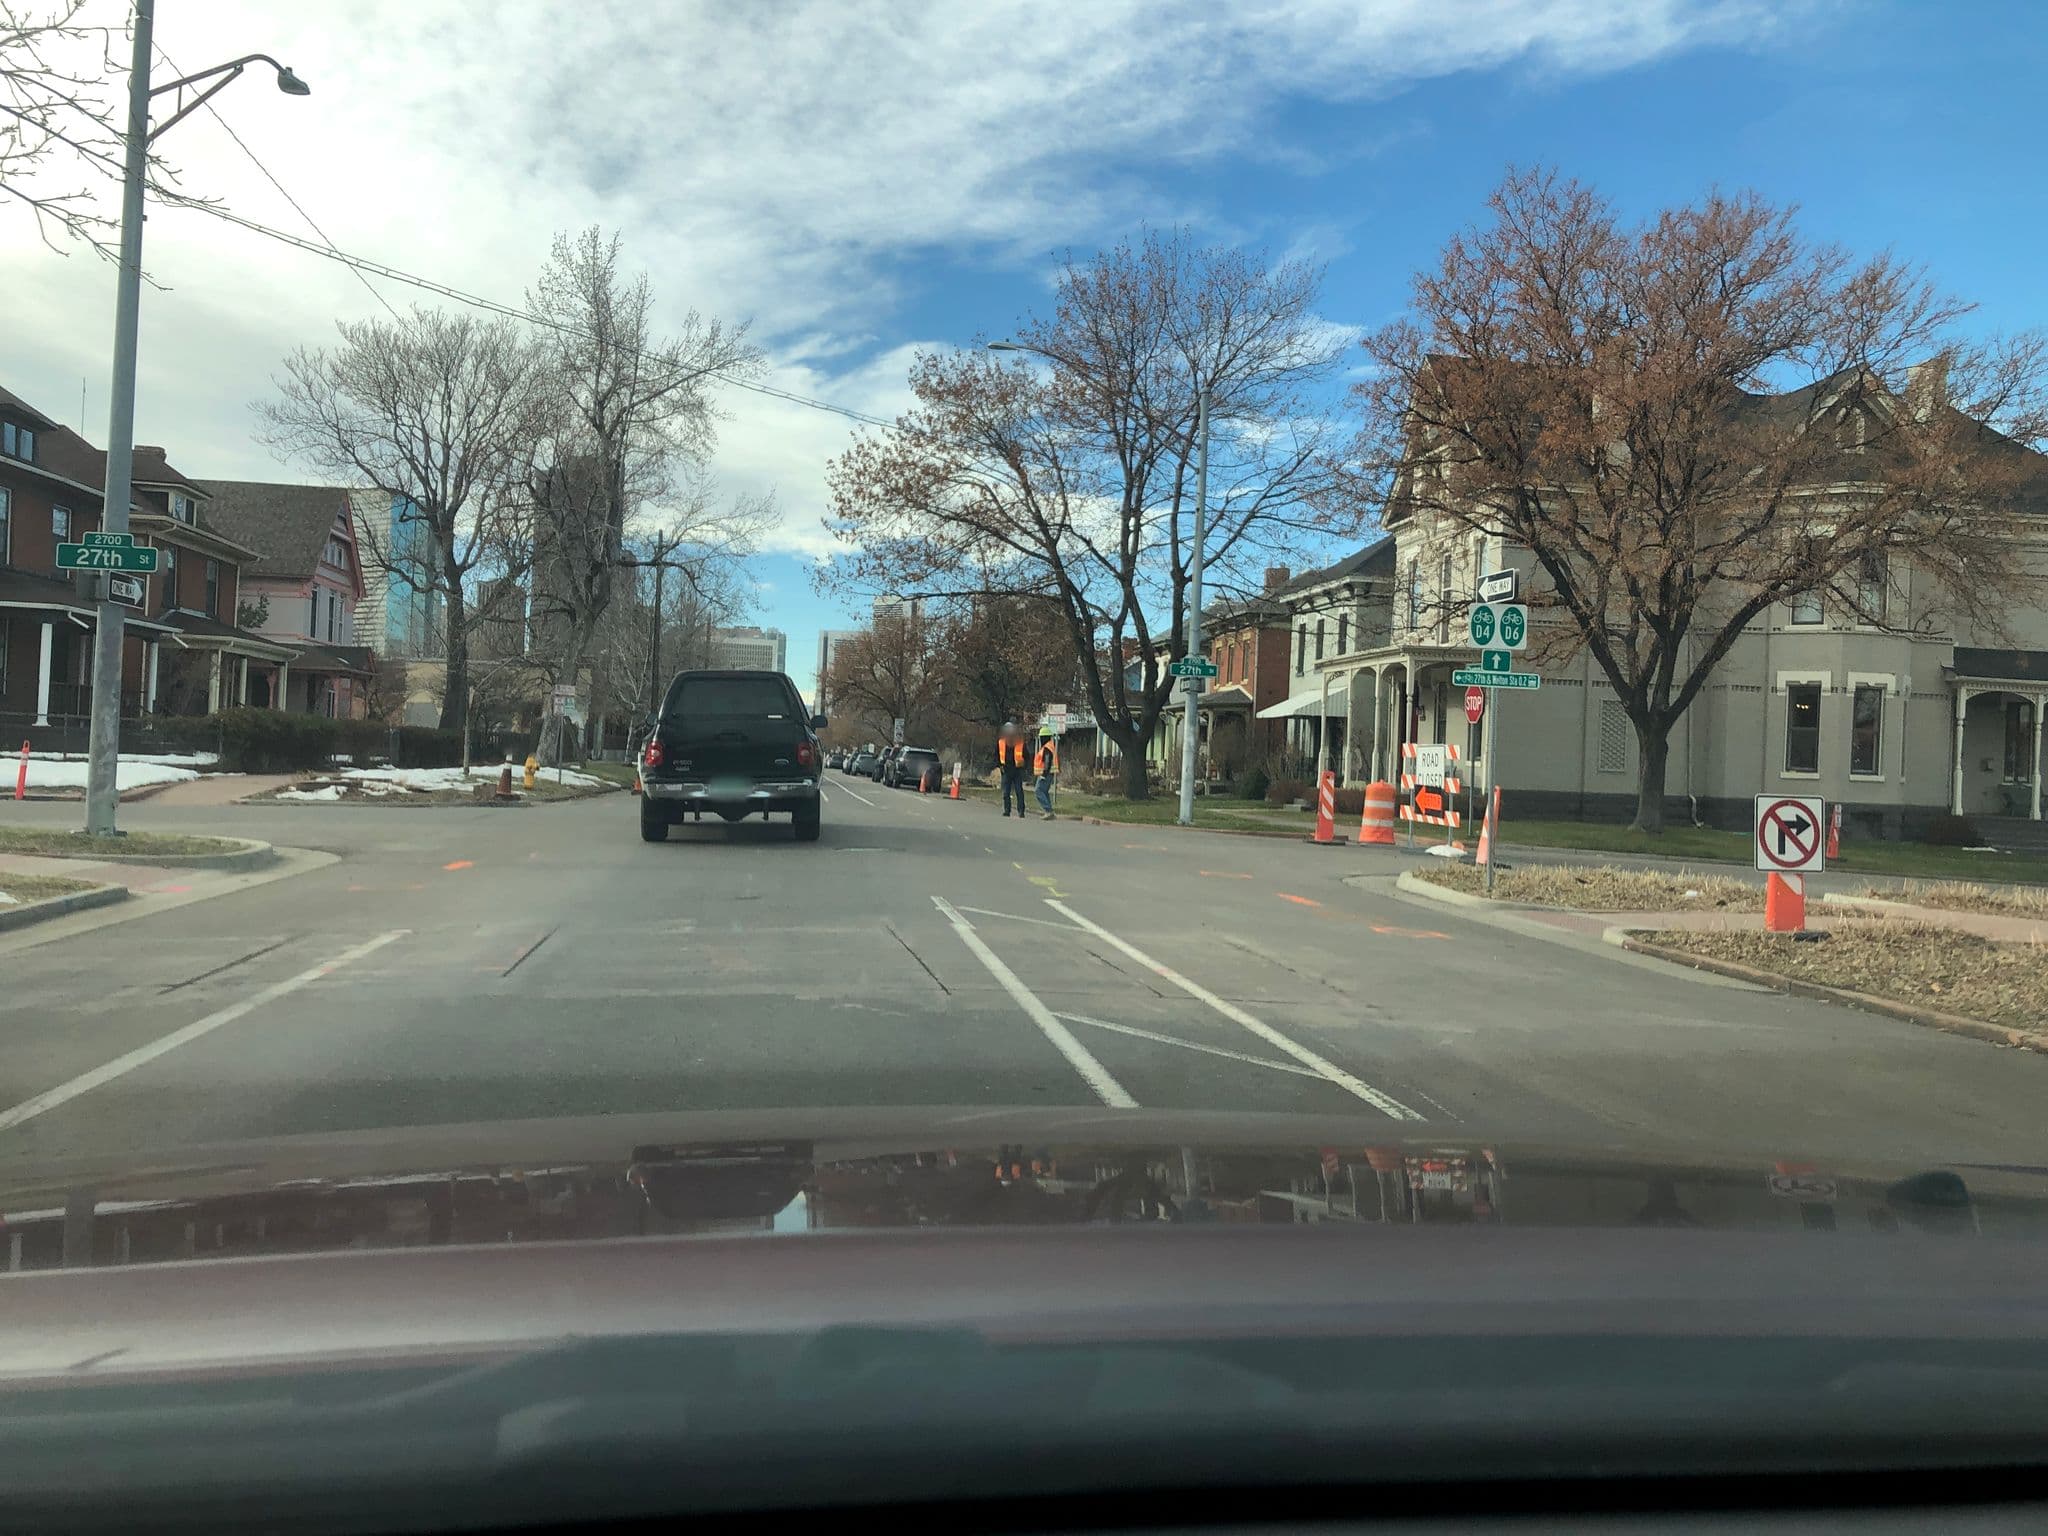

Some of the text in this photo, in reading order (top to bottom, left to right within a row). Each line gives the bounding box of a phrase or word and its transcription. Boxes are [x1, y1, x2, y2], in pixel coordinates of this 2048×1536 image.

[95, 535, 121, 544] 2700
[77, 549, 149, 566] 27th St
[113, 581, 123, 594] ONE
[1488, 579, 1510, 594] ONE WAY
[1476, 625, 1490, 639] D4
[1505, 626, 1519, 640] D6
[1180, 665, 1202, 675] 27th
[1474, 674, 1486, 685] 27th
[1486, 675, 1492, 685] &
[1466, 696, 1482, 711] STOP
[1421, 753, 1439, 767] ROAD
